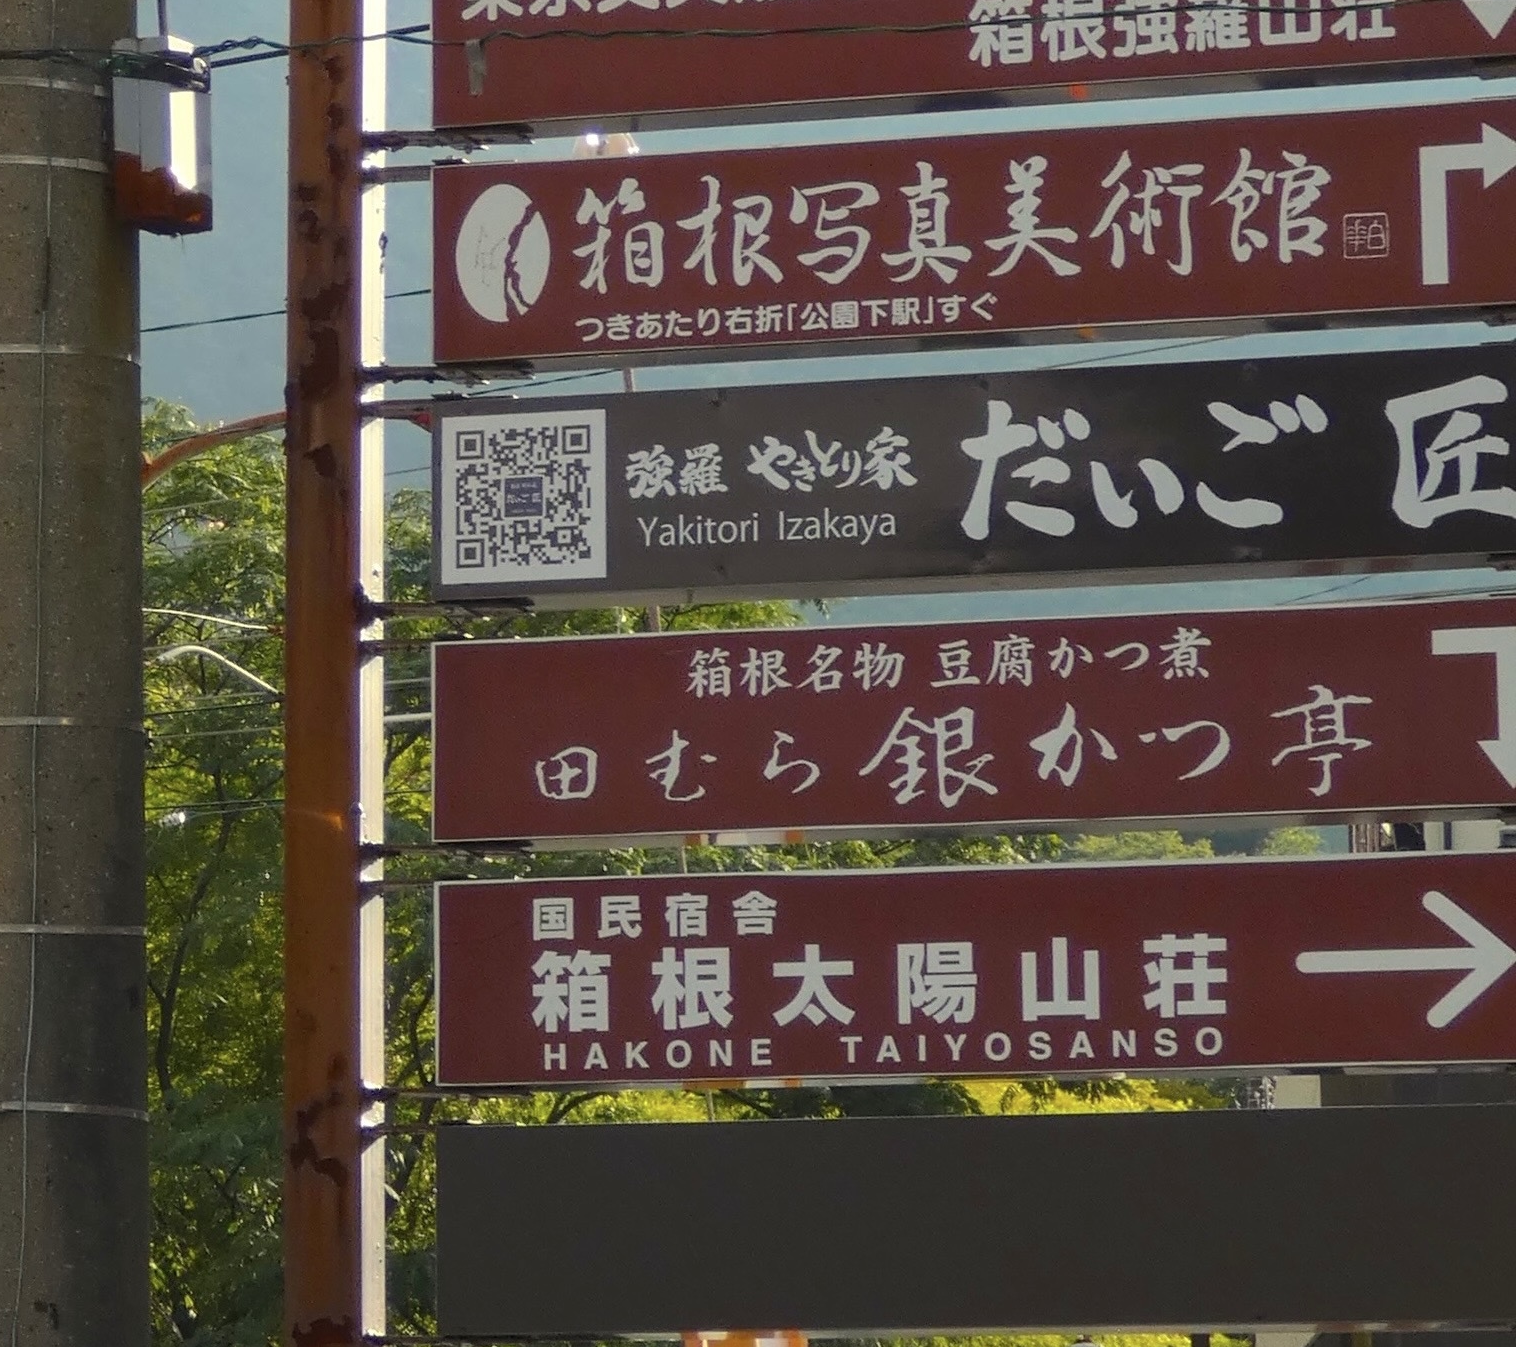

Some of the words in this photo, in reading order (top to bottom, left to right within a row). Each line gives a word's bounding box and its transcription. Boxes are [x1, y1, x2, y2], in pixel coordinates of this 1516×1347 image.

[572, 147, 1332, 295] 箱根写真美術館
[625, 442, 729, 499] 強羅
[960, 398, 1328, 541] だいご
[1384, 374, 1516, 529] 匠
[637, 512, 760, 548] Yakitori
[777, 507, 897, 546] Izakaya
[685, 641, 905, 699] 箱根名物
[928, 625, 1213, 690] 豆腐かつ煮
[531, 890, 778, 942] 国民宿舎
[530, 932, 1229, 1035] 箱根太陽山荘
[543, 1037, 774, 1073] HAKONE
[840, 1025, 1225, 1065] TAIYOSANSO
